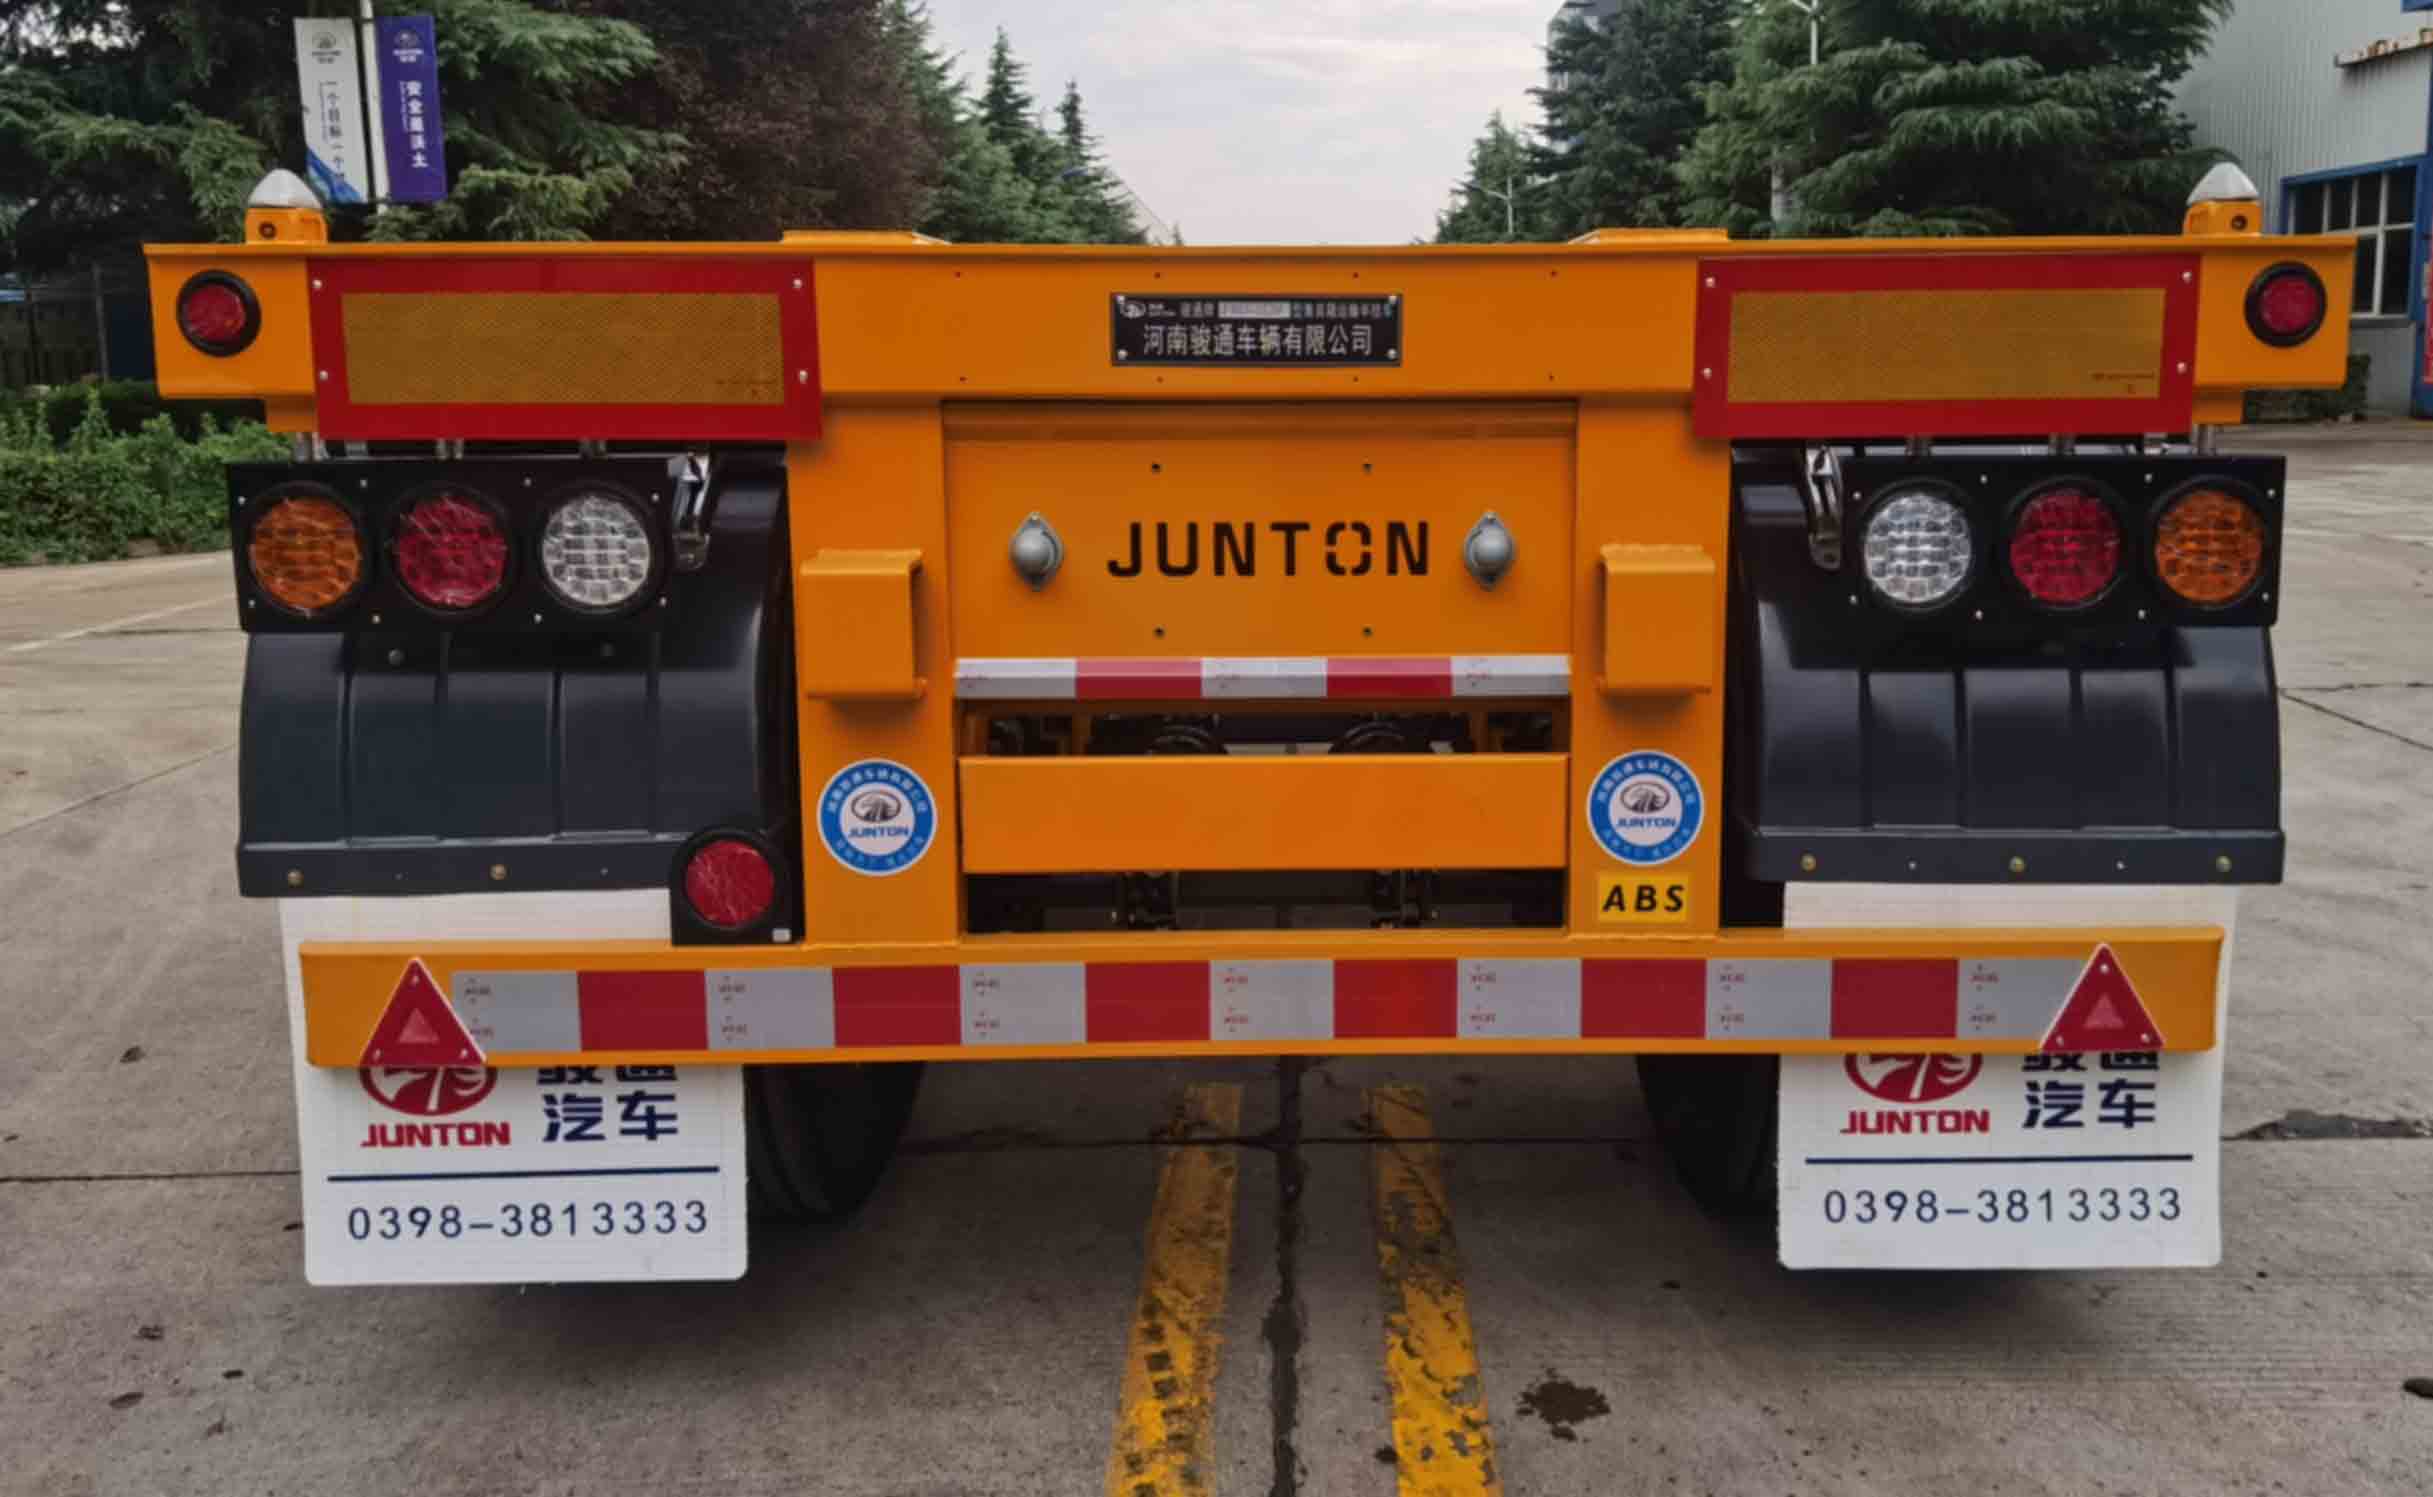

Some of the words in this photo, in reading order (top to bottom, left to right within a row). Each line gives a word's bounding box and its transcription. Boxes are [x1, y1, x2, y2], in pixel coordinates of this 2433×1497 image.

[1142, 323, 1373, 357] 河南骏通车辆有限公司
[1107, 521, 1429, 578] JUNTON
[1602, 884, 1685, 913] ABS
[541, 1090, 679, 1142] 汽车
[1840, 1109, 1991, 1135] JUNTON
[2022, 1078, 2157, 1129] 汽车
[361, 1121, 512, 1148] JUNTON
[348, 1200, 708, 1241] 0398-3813333
[1824, 1187, 2182, 1224] 0398-3813333
